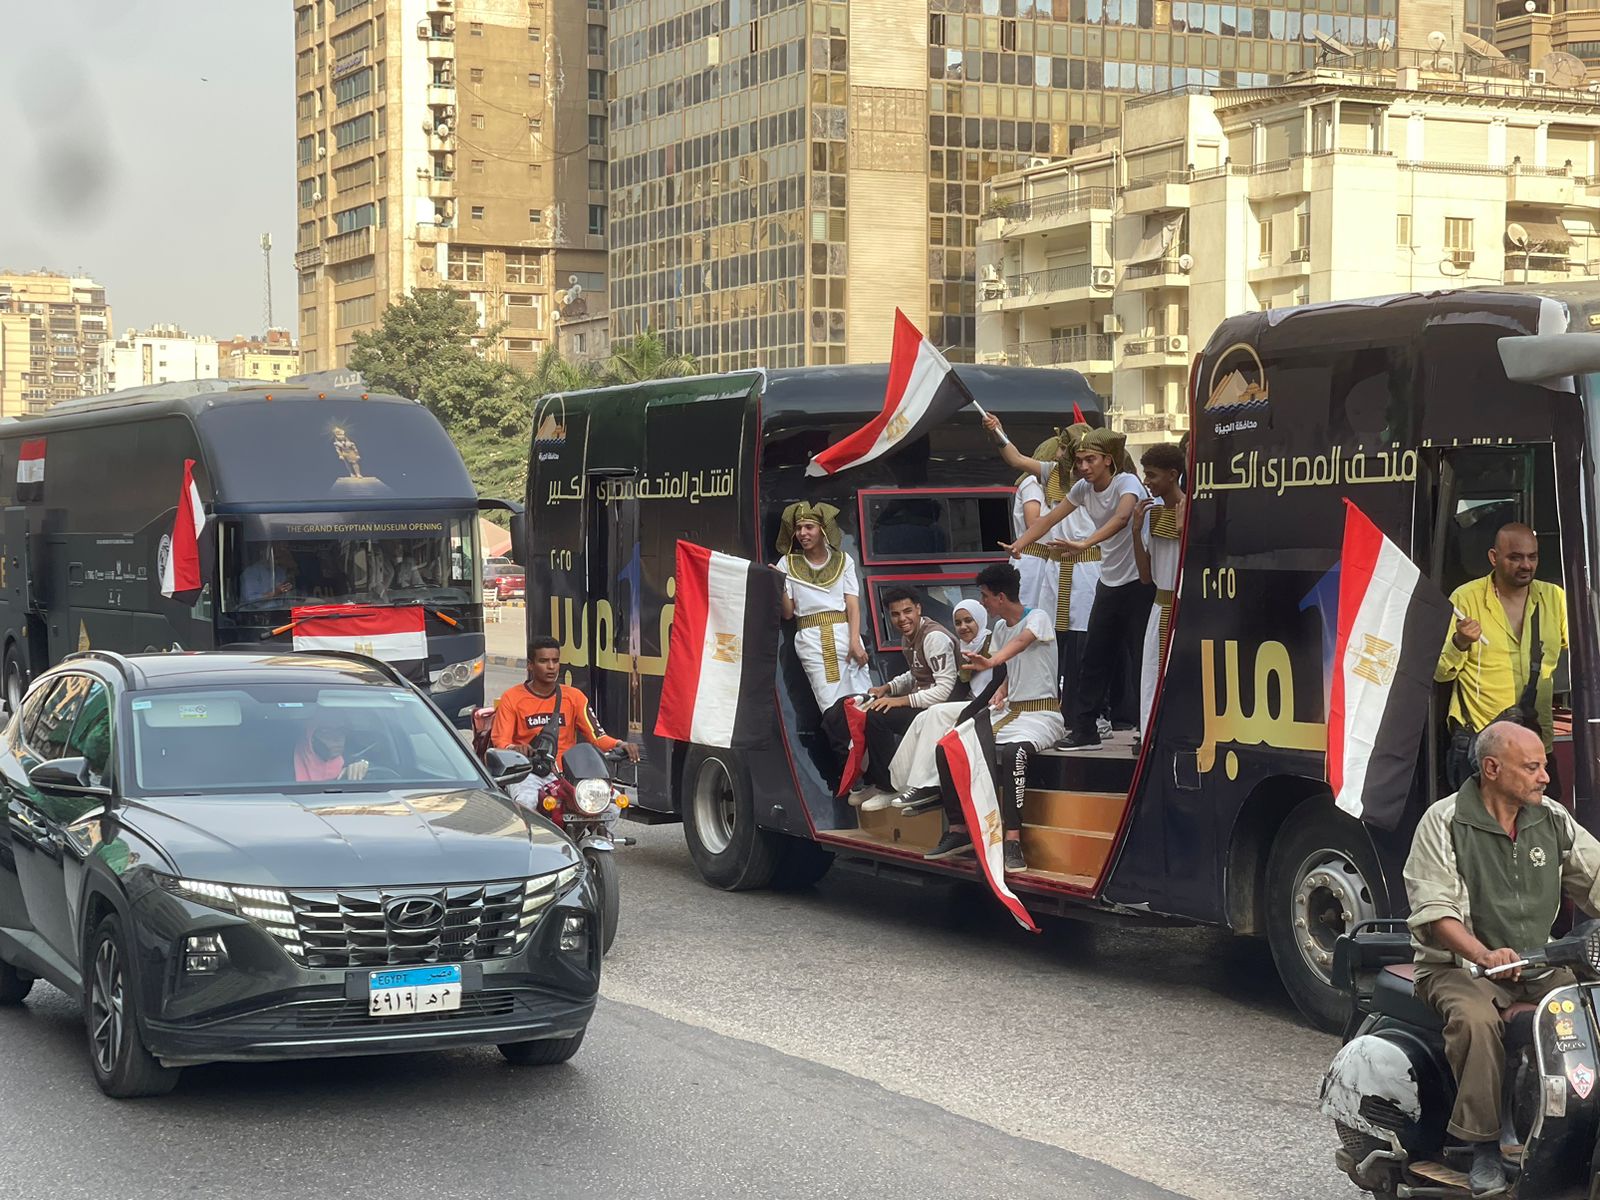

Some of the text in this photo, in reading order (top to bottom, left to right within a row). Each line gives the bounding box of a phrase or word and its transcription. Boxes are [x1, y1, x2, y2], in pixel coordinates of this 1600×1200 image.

[1345, 440, 1431, 485] متحف
[635, 471, 689, 499] المتحف
[1192, 450, 1258, 499] الكبير
[690, 468, 734, 504] افتتاح
[286, 522, 442, 533] THE GRAND EGYPTIAN MUSEUM OPENING
[550, 550, 572, 571] ٢٠٢٥
[1202, 567, 1236, 599] ٢٠٢٥
[930, 652, 947, 672] 07
[378, 974, 408, 985] EGYPT
[426, 970, 452, 981] مصر
[372, 992, 414, 1012] ٤٩١٩
